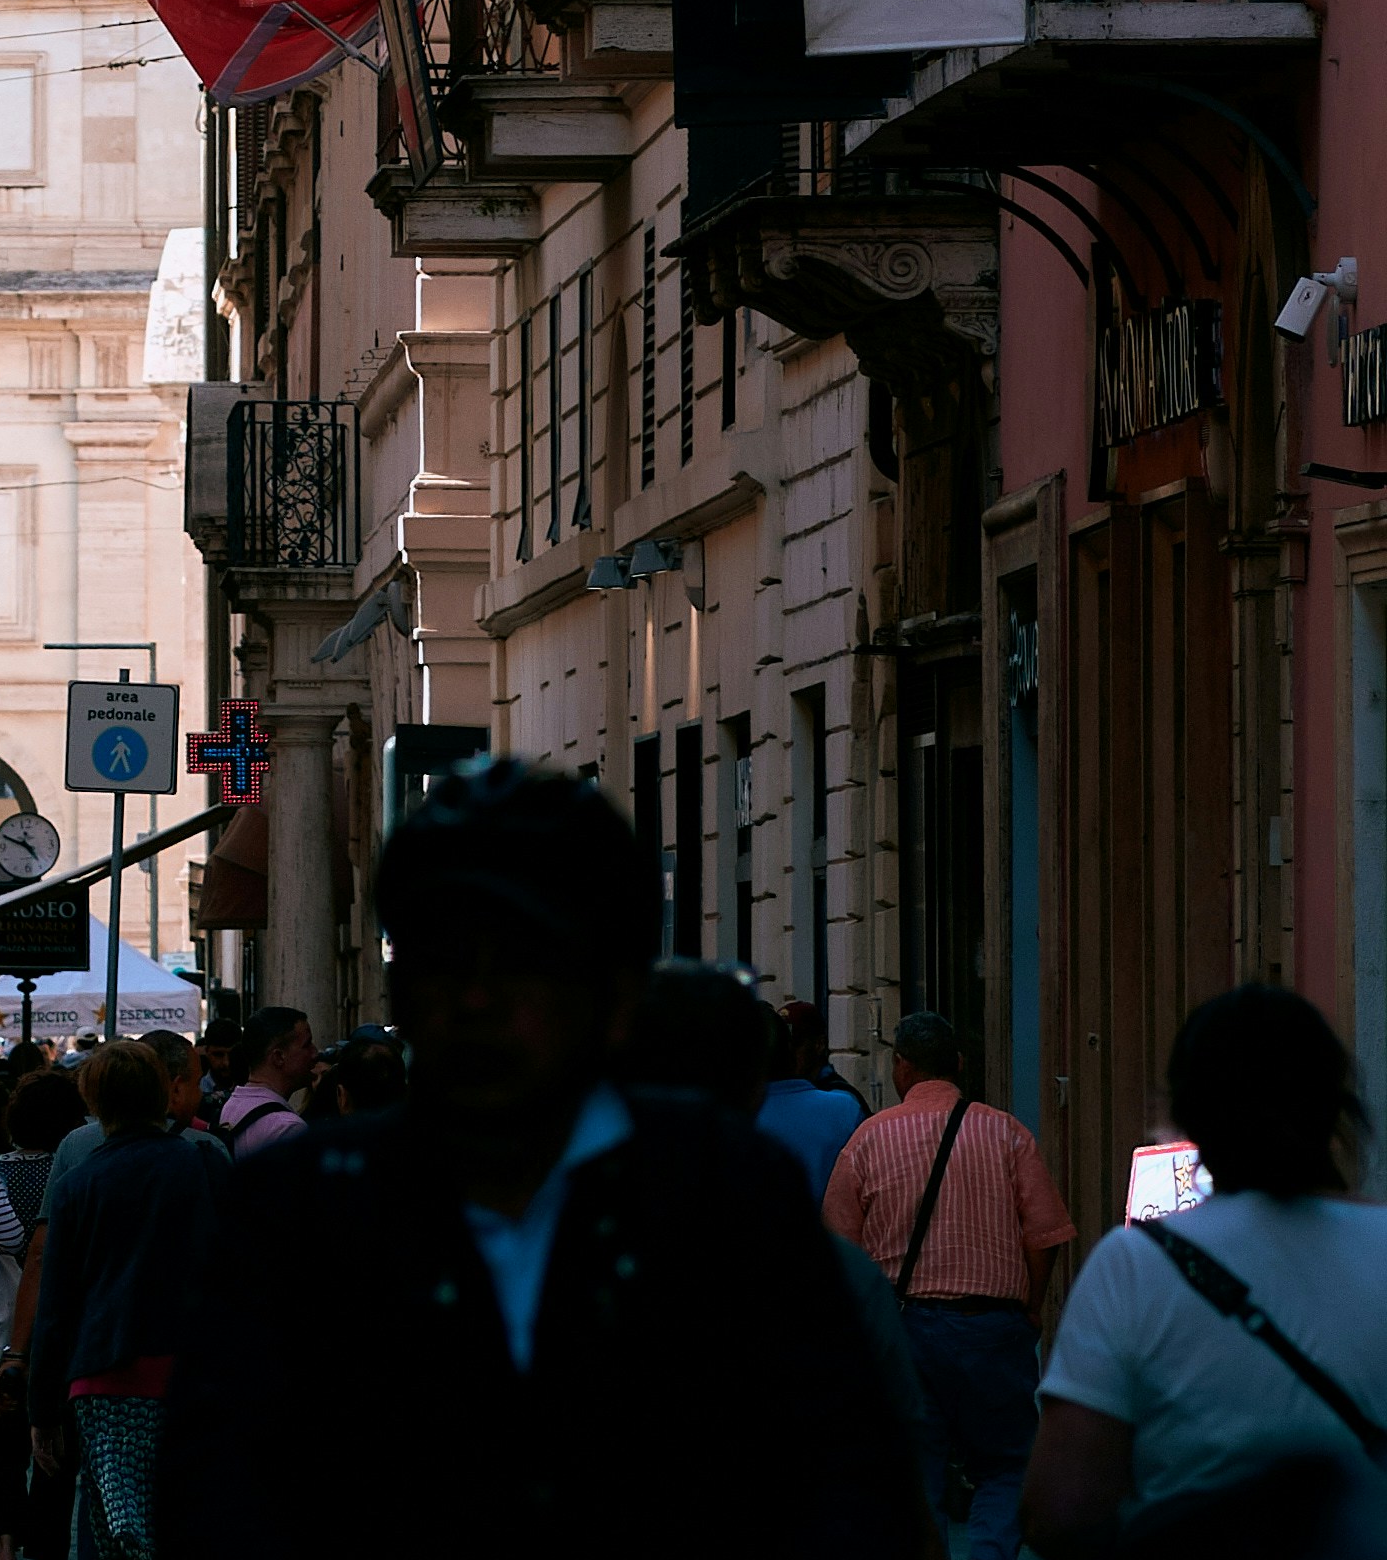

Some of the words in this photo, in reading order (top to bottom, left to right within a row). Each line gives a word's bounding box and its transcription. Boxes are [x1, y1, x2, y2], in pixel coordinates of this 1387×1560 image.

[107, 692, 139, 703] area
[87, 708, 156, 721] pedonale
[7, 901, 77, 919] USEO
[13, 1010, 77, 1023] EERCITO
[119, 1007, 186, 1021] ESERCITO
